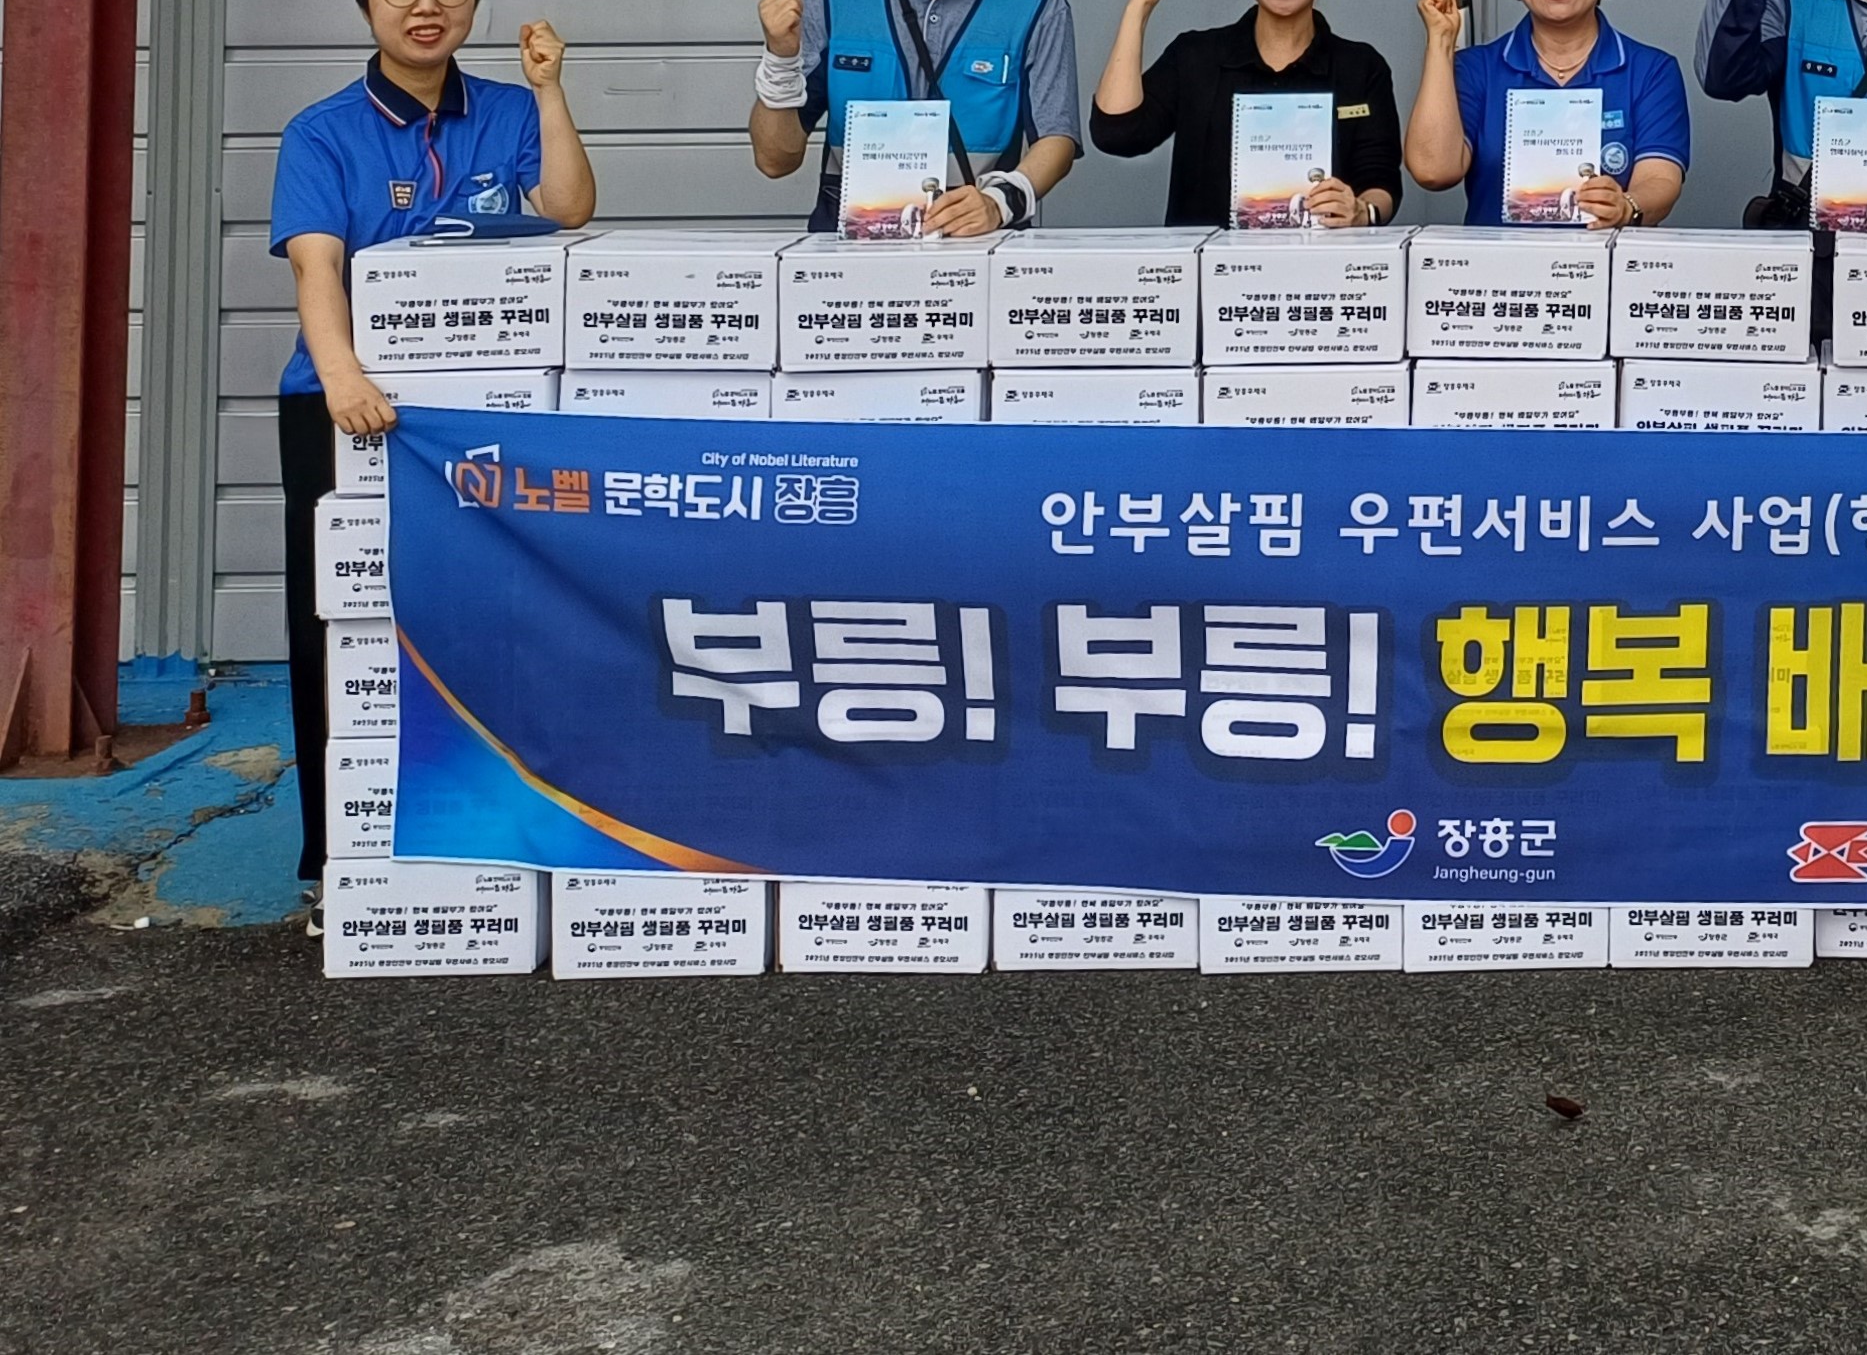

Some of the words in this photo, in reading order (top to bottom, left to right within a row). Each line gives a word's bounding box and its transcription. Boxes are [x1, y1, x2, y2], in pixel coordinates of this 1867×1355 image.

[370, 312, 436, 330] 안부살핌
[443, 310, 494, 328] 생필품
[500, 307, 550, 325] 꾸러미
[1008, 308, 1071, 325] 안부살핌
[1078, 308, 1127, 325] 생필품
[1132, 308, 1180, 324] 꾸러미
[1218, 306, 1280, 323] 안부살핌
[1286, 305, 1334, 322] 생필품
[1340, 305, 1387, 322] 꾸러미
[1425, 300, 1486, 317] 안부살핌
[1492, 302, 1540, 318] 생필품
[1545, 303, 1592, 320] 꾸러미
[1629, 302, 1690, 319] 안부살핌
[1696, 304, 1744, 321] 생필품
[1749, 305, 1796, 322] 꾸러미
[582, 312, 647, 329] 안부살핌
[654, 313, 704, 329] 생필품
[710, 313, 759, 331] 꾸러미
[797, 313, 862, 330] 안부살핌
[868, 312, 919, 329] 생필품
[925, 311, 974, 328] 꾸러미
[352, 435, 384, 451] 안부
[701, 451, 728, 467] City
[731, 452, 746, 466] of
[748, 453, 790, 467] Nobel
[791, 453, 859, 467] Literature
[513, 466, 591, 513] 노벨
[603, 470, 763, 521] 문학도시
[774, 473, 860, 525] 장흥
[1039, 491, 1305, 557] 안부살핌
[1339, 492, 1662, 556] 우편서비스
[335, 560, 384, 577] 안부살
[345, 679, 397, 696] 안부살
[661, 597, 997, 743] 부릉!
[1053, 603, 1381, 761] 부릉!
[1435, 603, 1713, 765] 행복
[344, 800, 392, 817] 안부살
[1435, 815, 1558, 859] 장흥군
[1432, 863, 1557, 884] Jangheung-gun
[342, 920, 407, 937] 안부살핌
[413, 919, 463, 936] 생필품
[470, 917, 519, 934] 꾸러미
[798, 914, 860, 931] 안부살핌
[866, 915, 915, 932] 생필품
[920, 915, 968, 933] 꾸러미
[1012, 912, 1075, 929] 안부살핌
[1081, 912, 1130, 929] 생필품
[1136, 912, 1184, 929] 꾸러미
[1217, 915, 1281, 933] 안부살핌
[1287, 915, 1336, 932] 생필품
[1342, 914, 1390, 931] 꾸러미
[1421, 913, 1484, 931] 안부살핌
[1491, 912, 1539, 930] 생필품
[1545, 911, 1593, 928] 꾸러미
[1628, 909, 1690, 927] 안부살핌
[1696, 910, 1745, 927] 생필품
[1750, 910, 1798, 927] 꾸러미
[570, 920, 635, 938] 안부살핌
[641, 920, 691, 937] 생필품
[697, 918, 747, 936] 꾸러미
